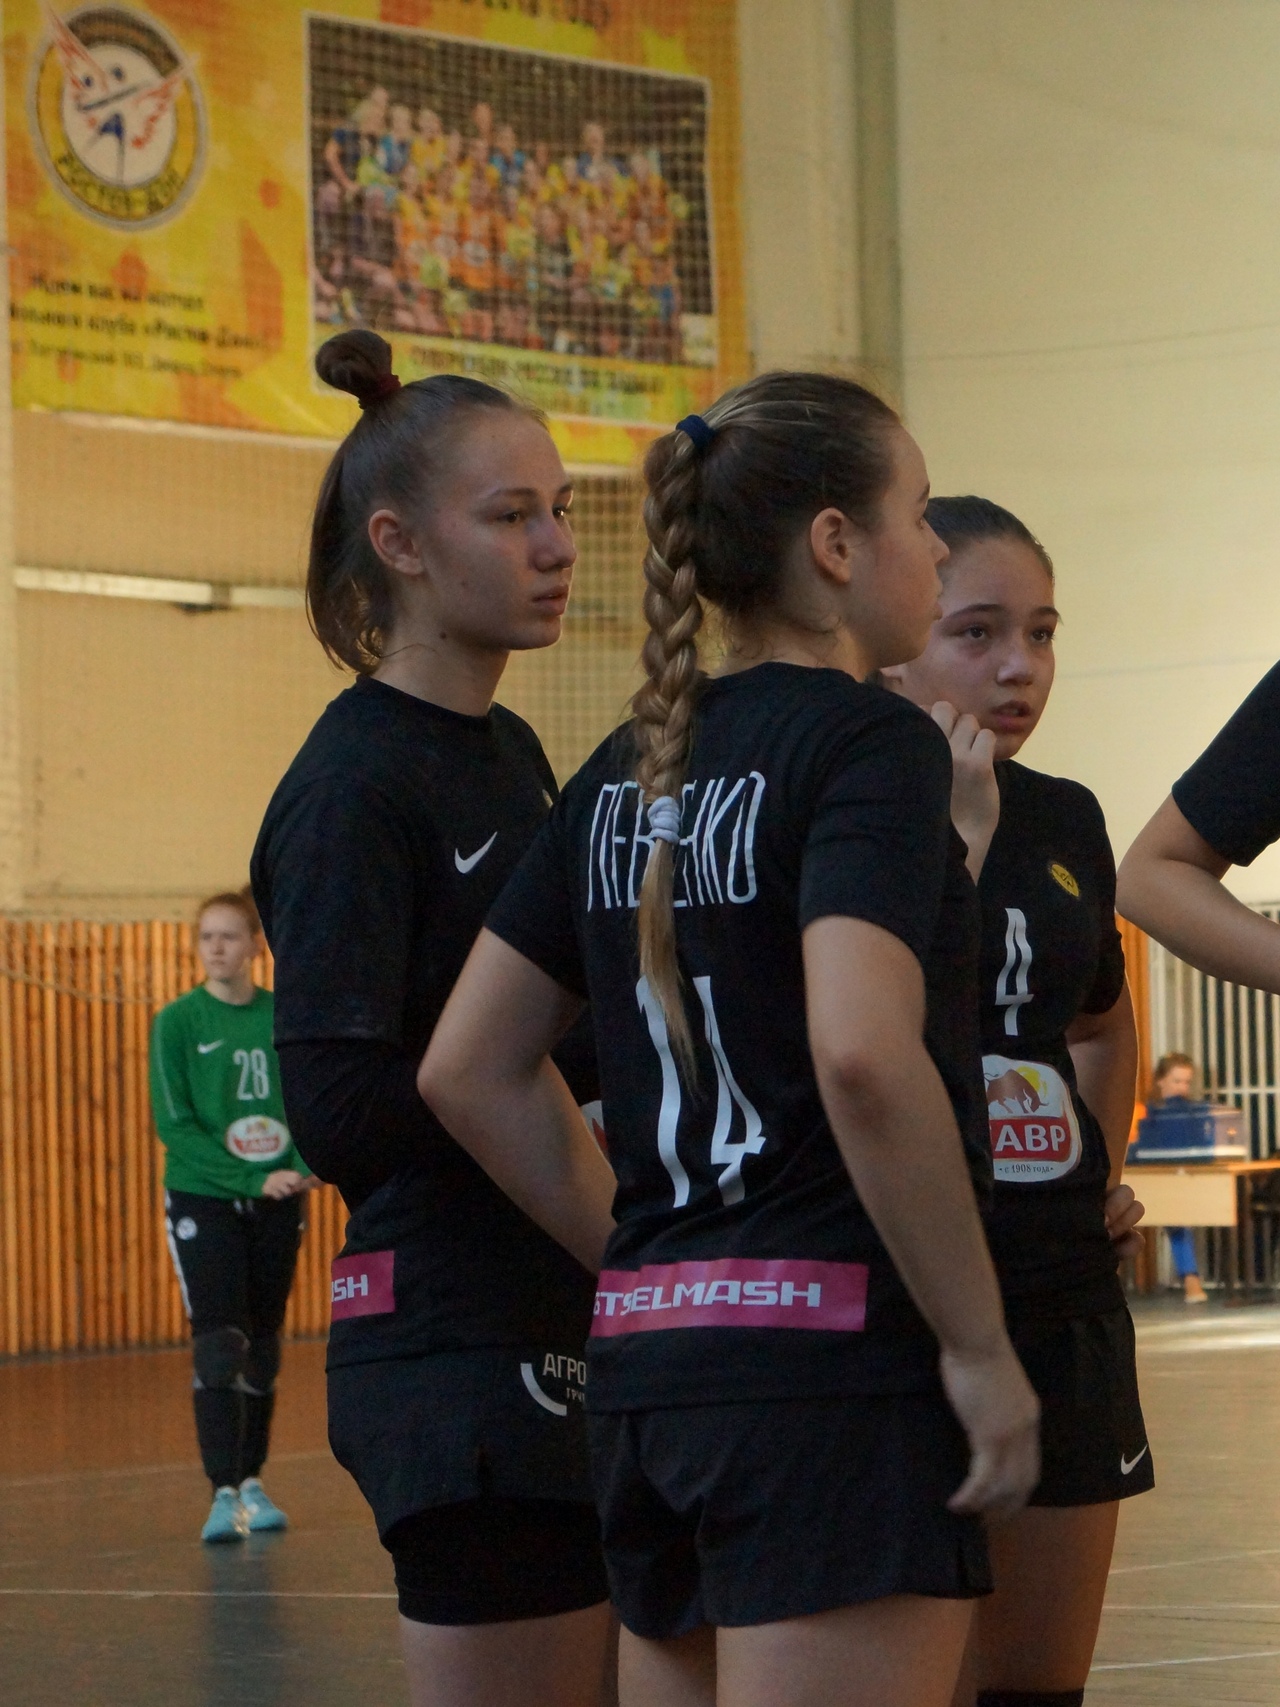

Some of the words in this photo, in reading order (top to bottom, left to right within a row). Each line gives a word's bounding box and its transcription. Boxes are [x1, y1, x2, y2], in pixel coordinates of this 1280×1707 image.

[995, 907, 1034, 1036] 4
[233, 1048, 270, 1100] 28
[635, 975, 767, 1208] 14
[990, 1124, 1066, 1152] АВР
[331, 1274, 369, 1303] SH
